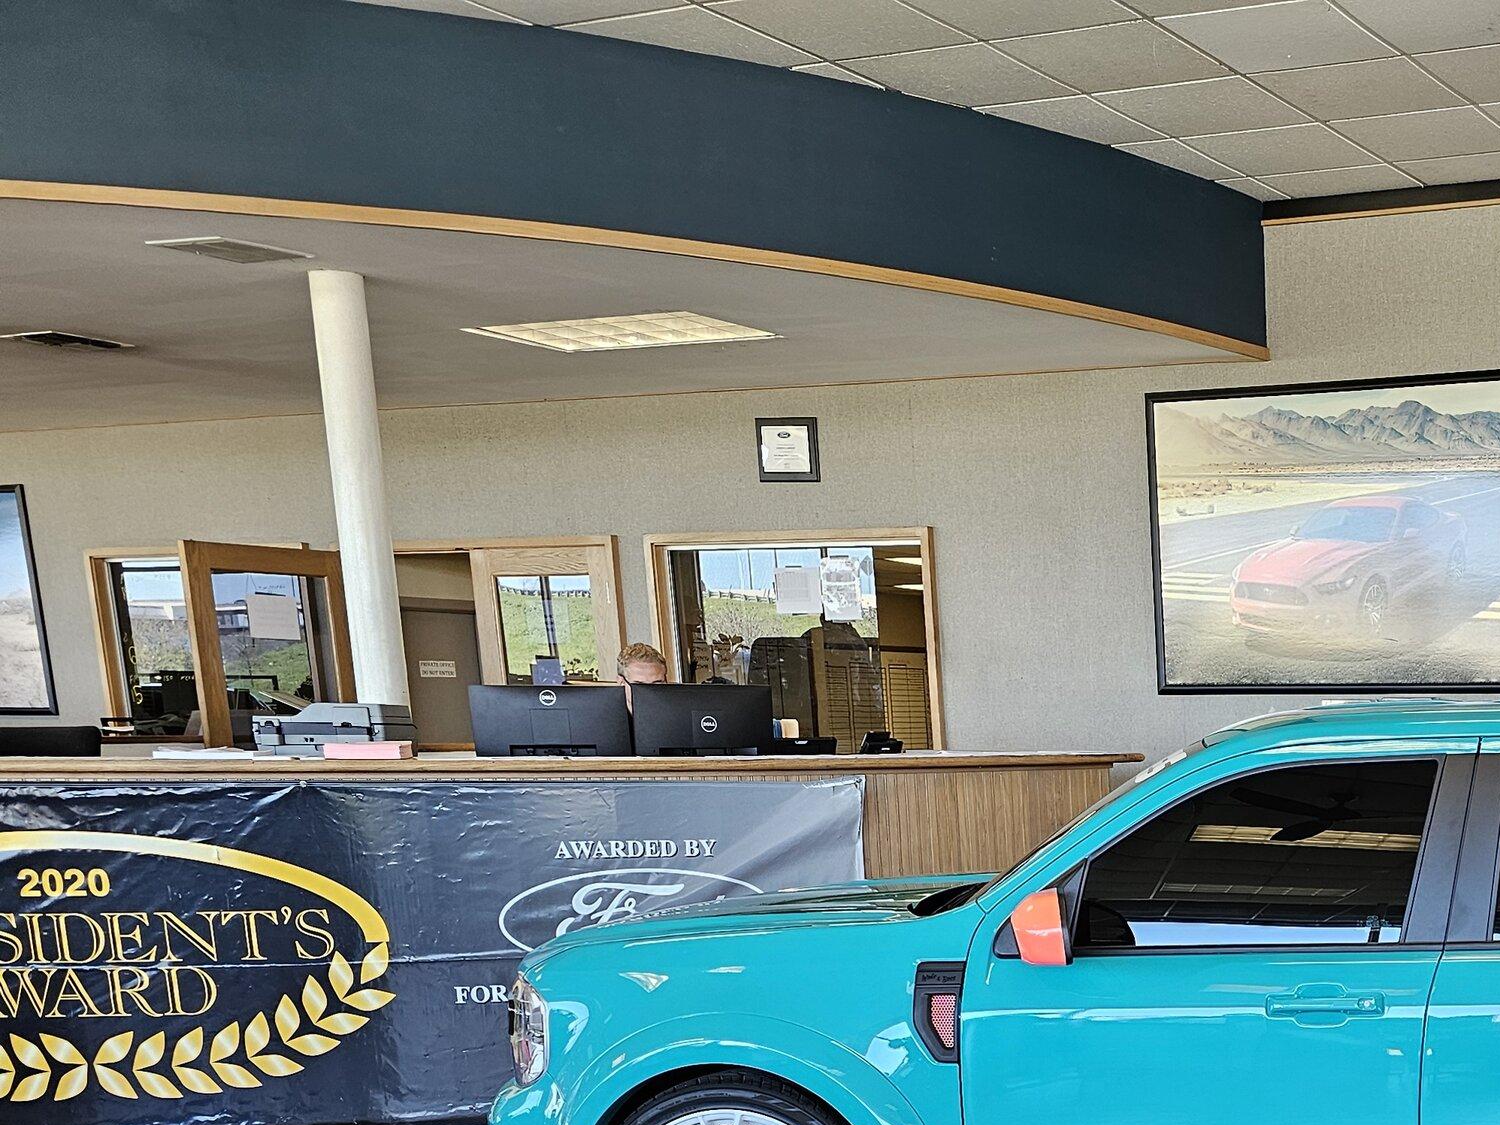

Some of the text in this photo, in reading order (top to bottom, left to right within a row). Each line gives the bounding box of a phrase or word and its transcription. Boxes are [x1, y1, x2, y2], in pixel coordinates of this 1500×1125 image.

[554, 838, 717, 860] AWARDED BY
[16, 868, 112, 898] 2020
[0, 966, 217, 1018] WARD
[453, 984, 509, 1004] FOR
